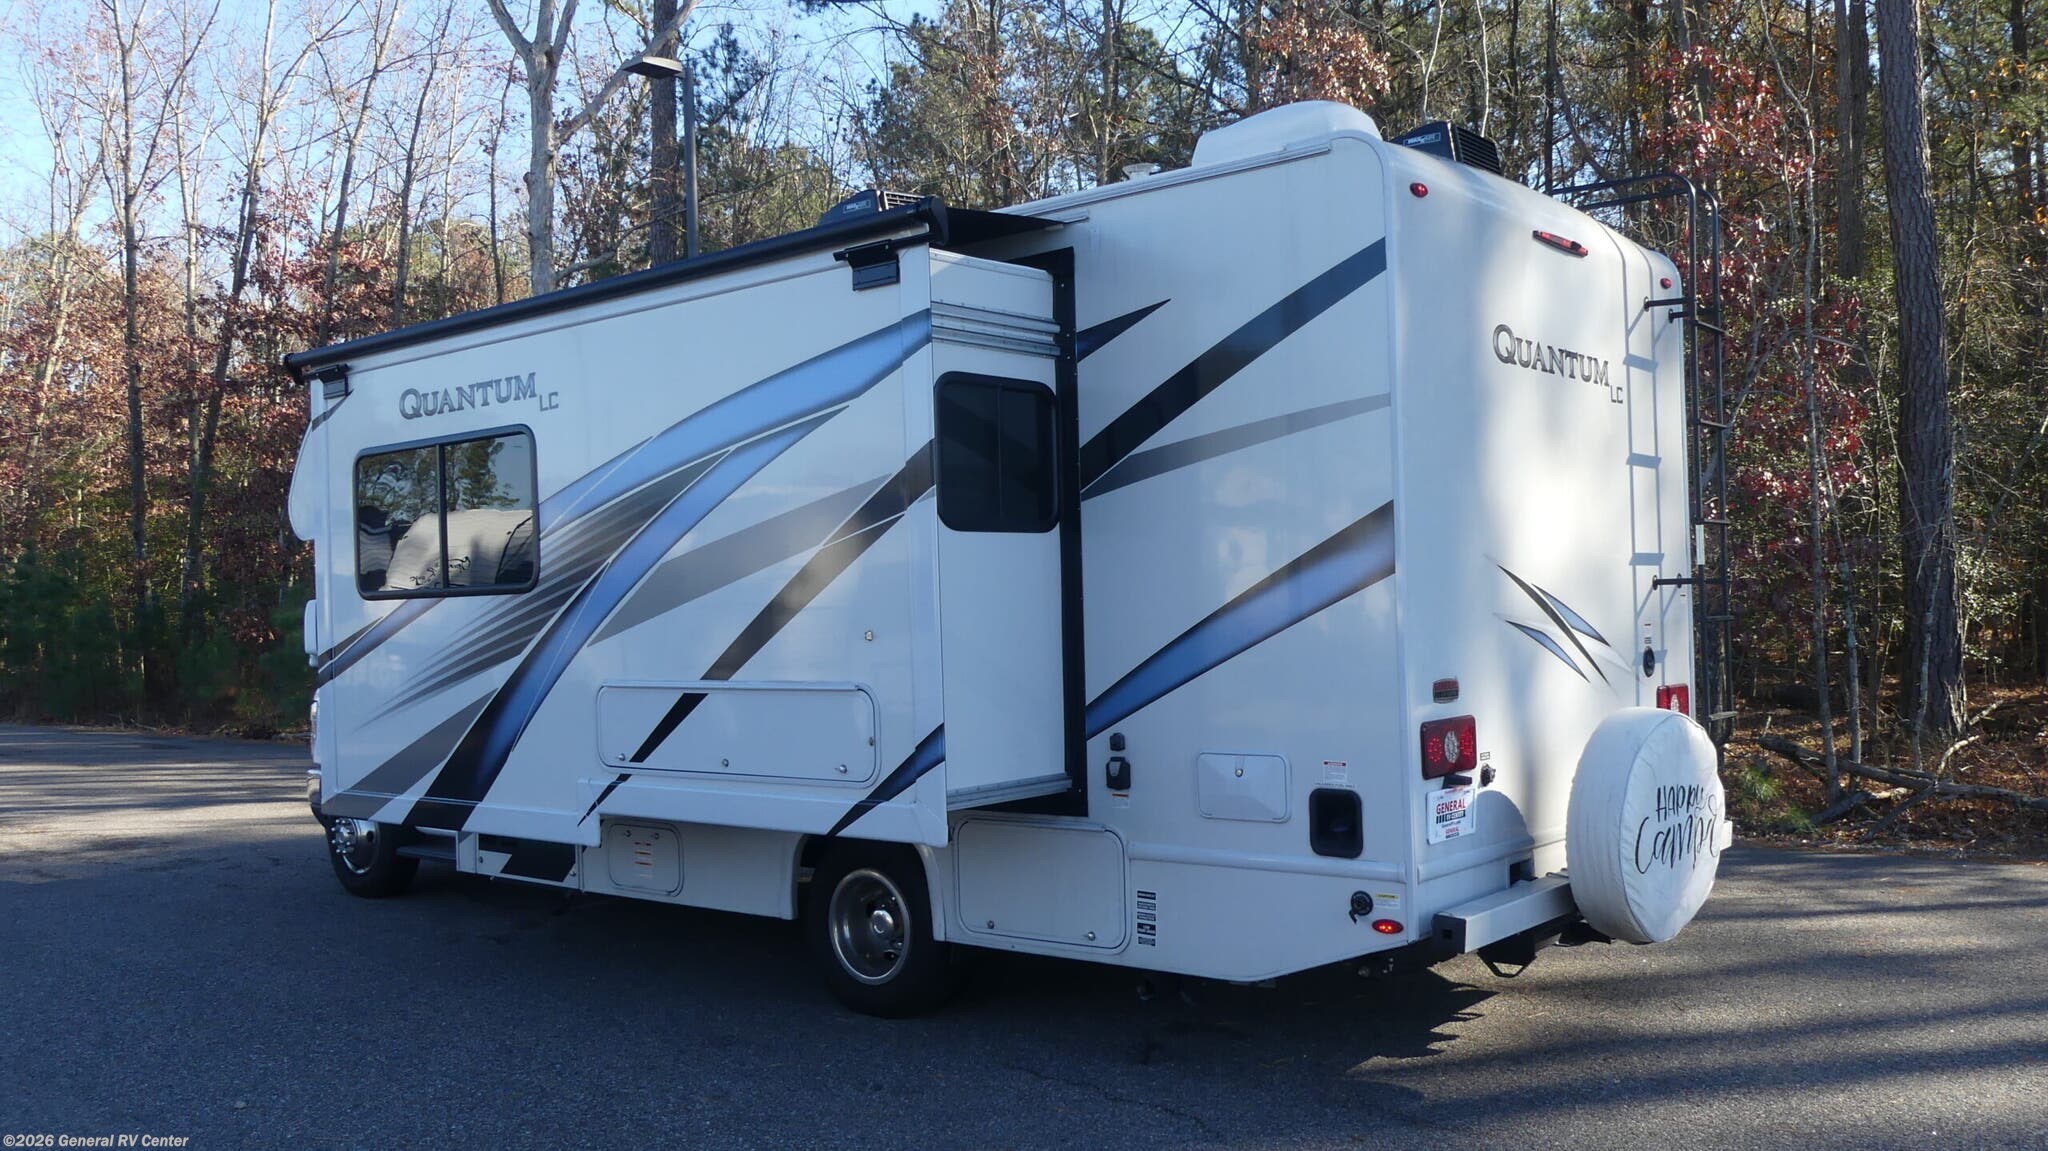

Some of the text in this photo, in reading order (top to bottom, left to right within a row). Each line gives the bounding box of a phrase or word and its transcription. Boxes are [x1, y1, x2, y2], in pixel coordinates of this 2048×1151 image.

[1492, 324, 1609, 387] QUANTUM
[399, 372, 537, 420] QUANTUM
[539, 391, 559, 412] LC
[1610, 385, 1623, 404] LC
[1436, 798, 1465, 815] GENERAL
